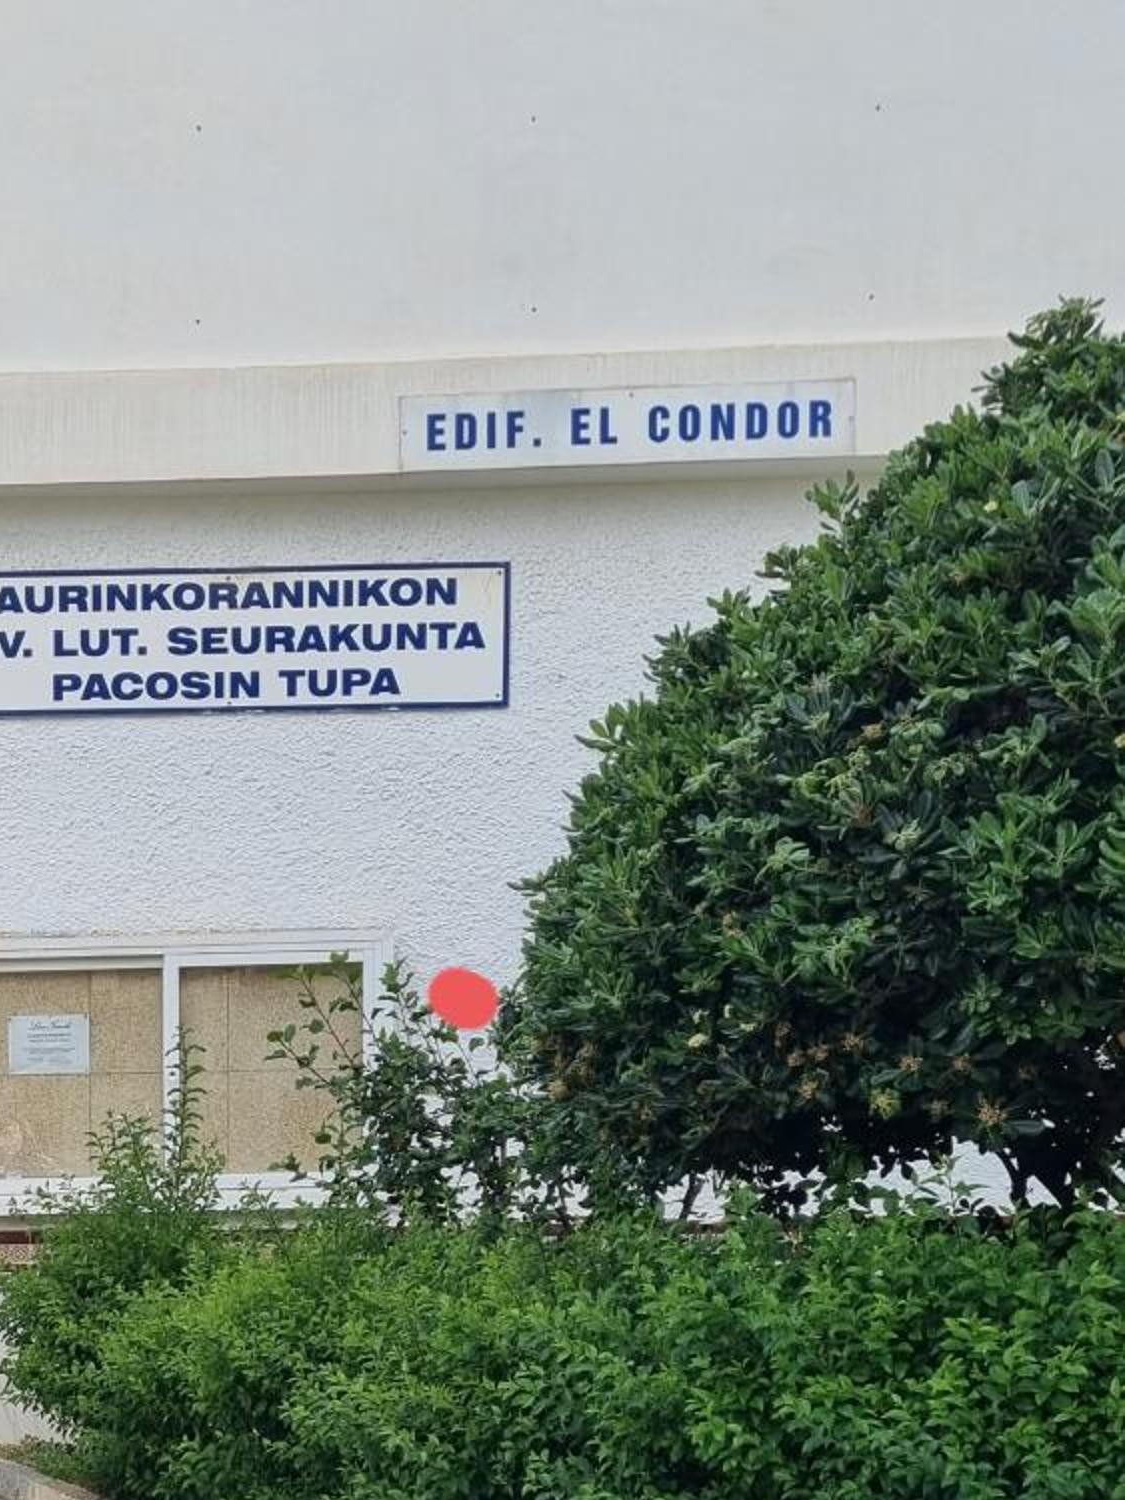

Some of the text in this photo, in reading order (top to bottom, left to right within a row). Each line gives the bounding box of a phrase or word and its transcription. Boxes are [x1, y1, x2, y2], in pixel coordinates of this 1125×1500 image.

[427, 399, 832, 451] EDIF. EL CONDOR
[53, 628, 148, 658] LUT.
[167, 621, 486, 656] SEURAKUNTA
[52, 667, 401, 701] PACOSIN TUPA
